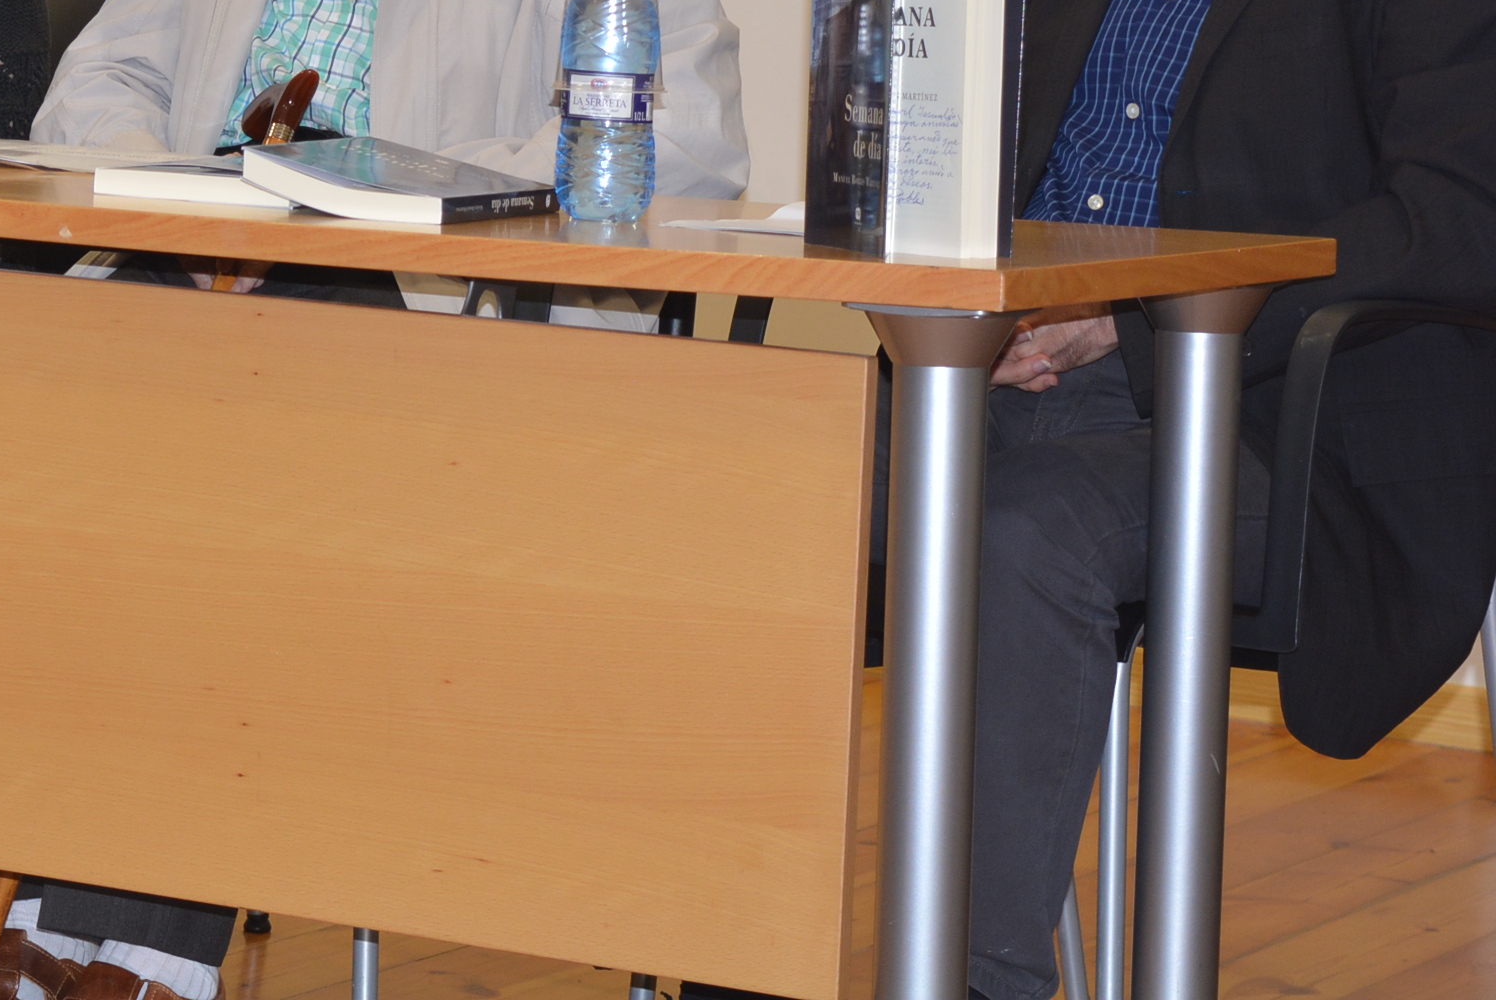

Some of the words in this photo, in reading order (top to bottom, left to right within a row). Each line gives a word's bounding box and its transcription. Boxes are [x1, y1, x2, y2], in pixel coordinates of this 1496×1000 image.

[573, 96, 583, 106] LA
[584, 98, 627, 109] SERRETA
[901, 91, 939, 102] MARTÍNEZ
[844, 93, 884, 126] Semana
[853, 129, 866, 159] de
[867, 131, 882, 160] día
[491, 199, 502, 214] día
[510, 195, 535, 210] Semana
